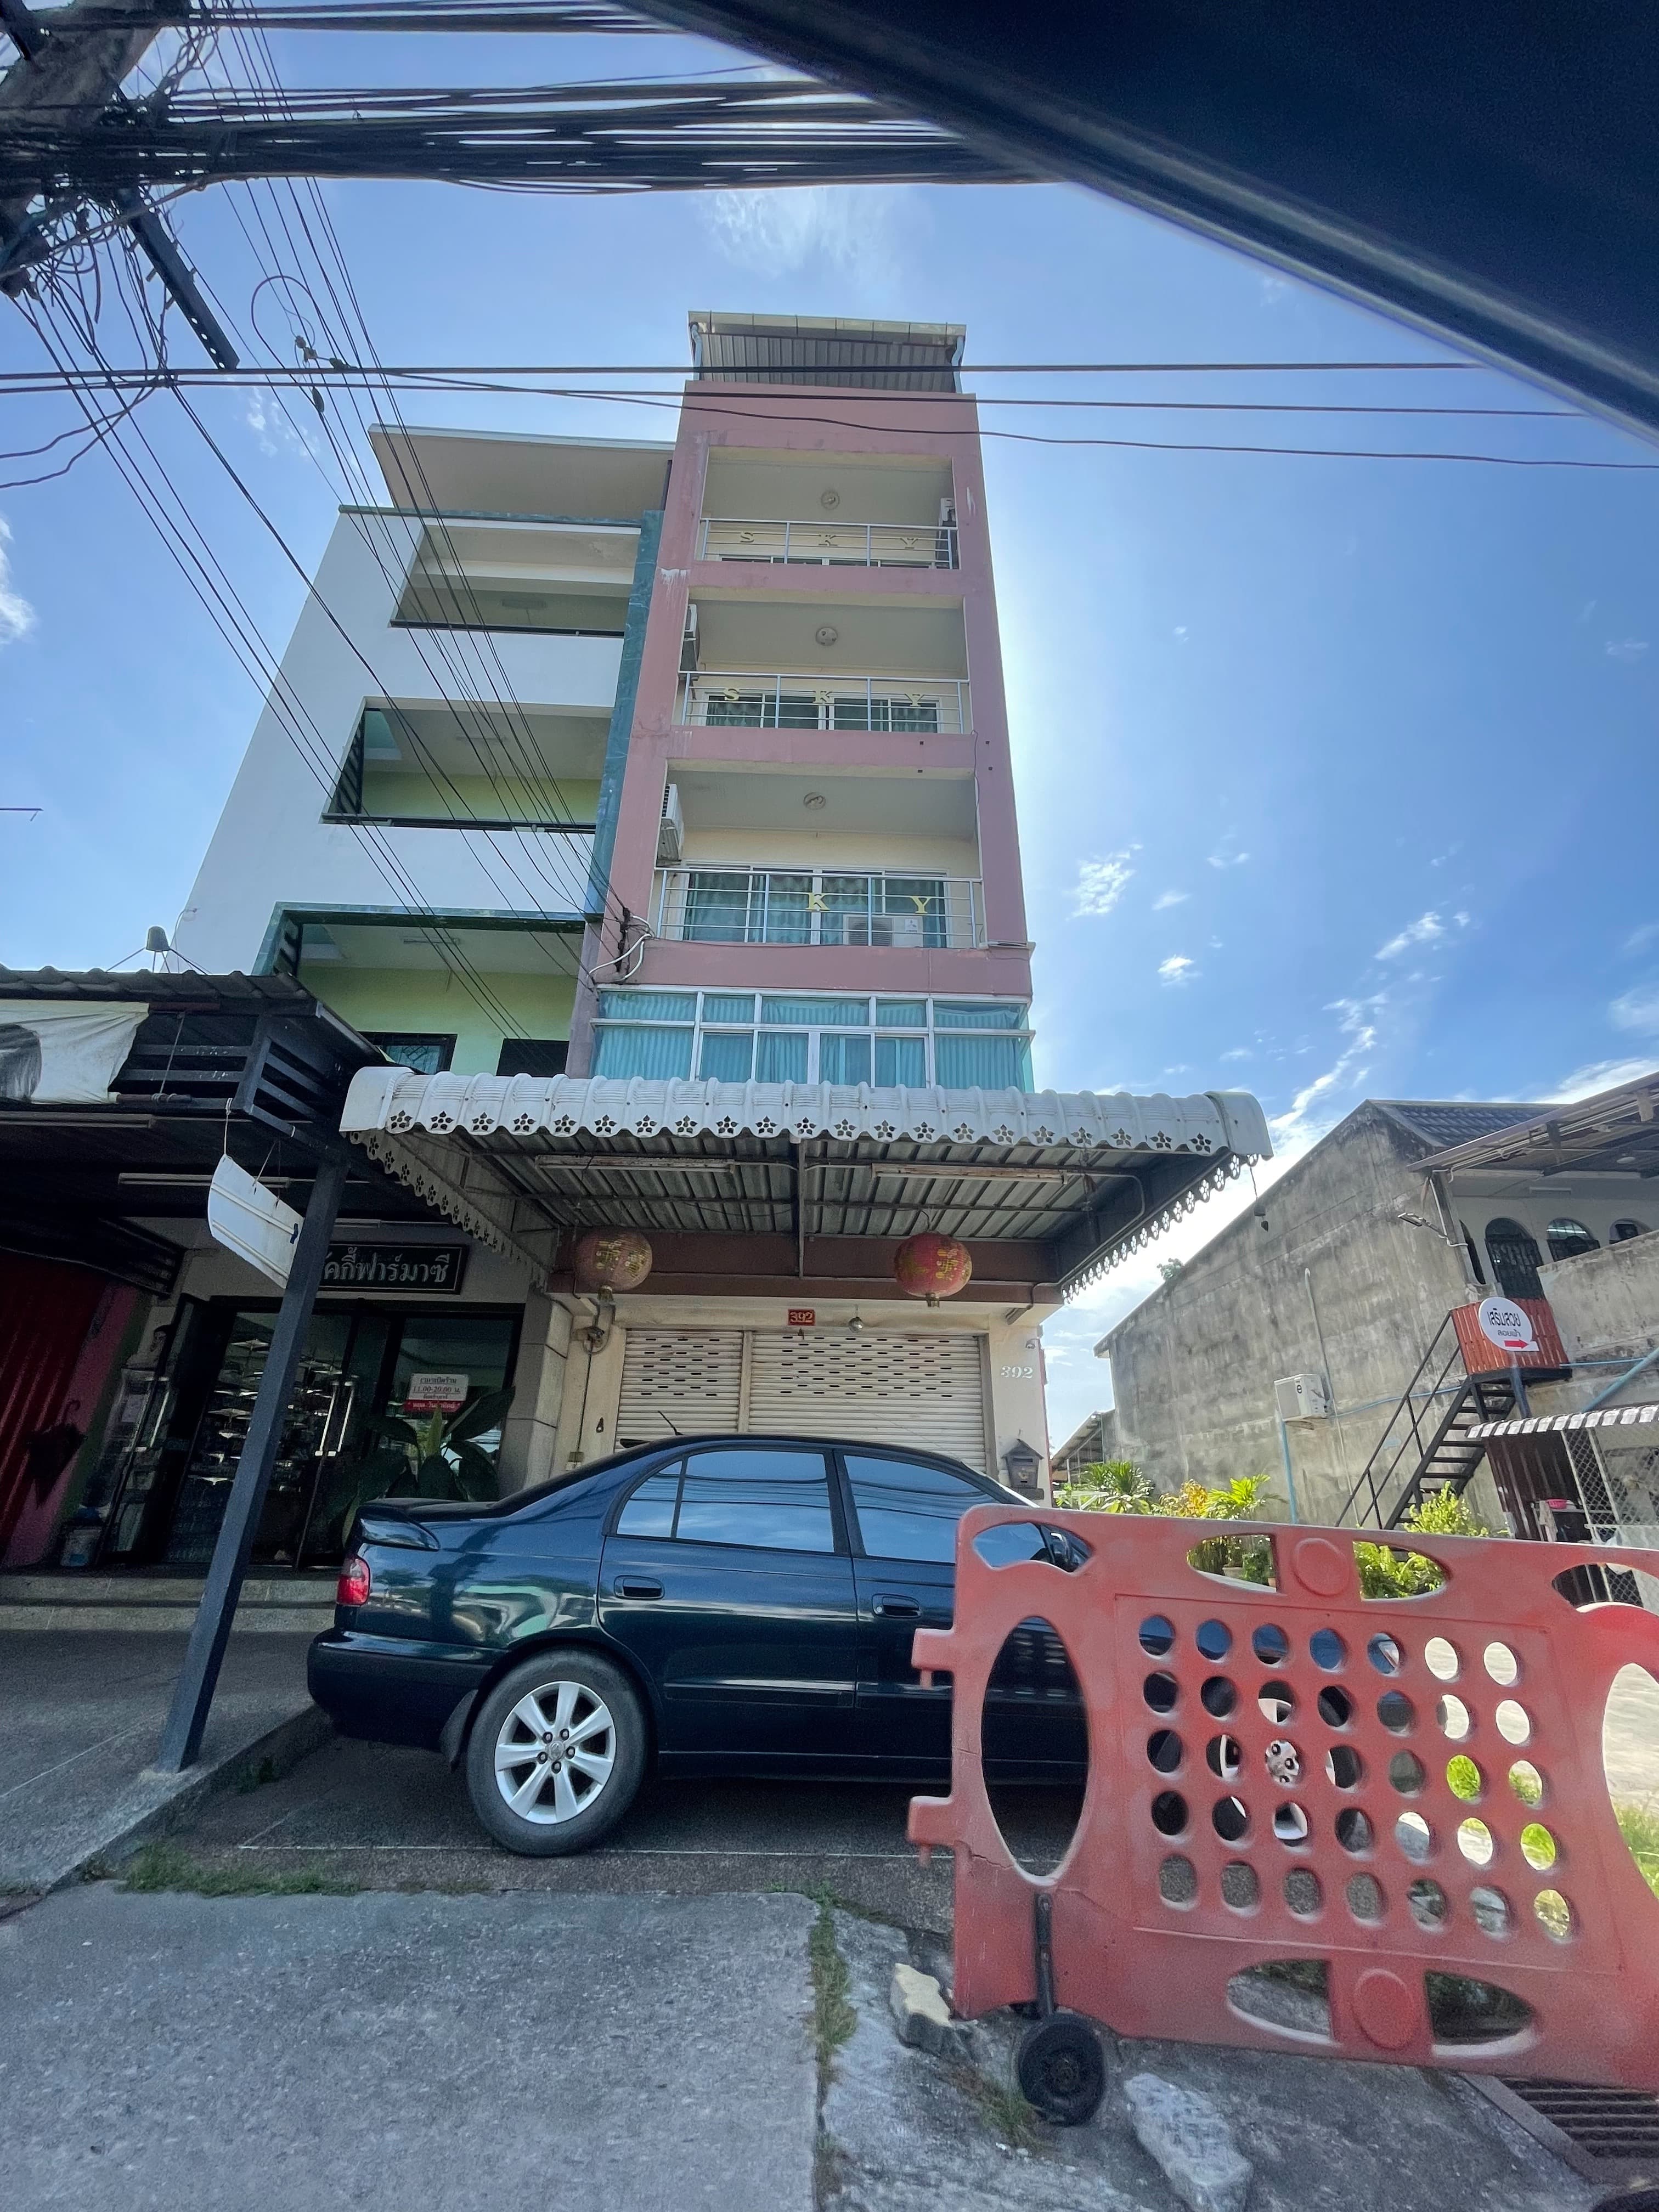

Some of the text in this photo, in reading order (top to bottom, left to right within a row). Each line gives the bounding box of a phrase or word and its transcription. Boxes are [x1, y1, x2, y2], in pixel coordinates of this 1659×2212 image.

[324, 1246, 450, 1283] คกี้ฟาร์มาซี
[789, 1312, 813, 1323] 392
[1487, 1307, 1521, 1327] เสริมสวย
[1001, 1365, 1033, 1379] 392
